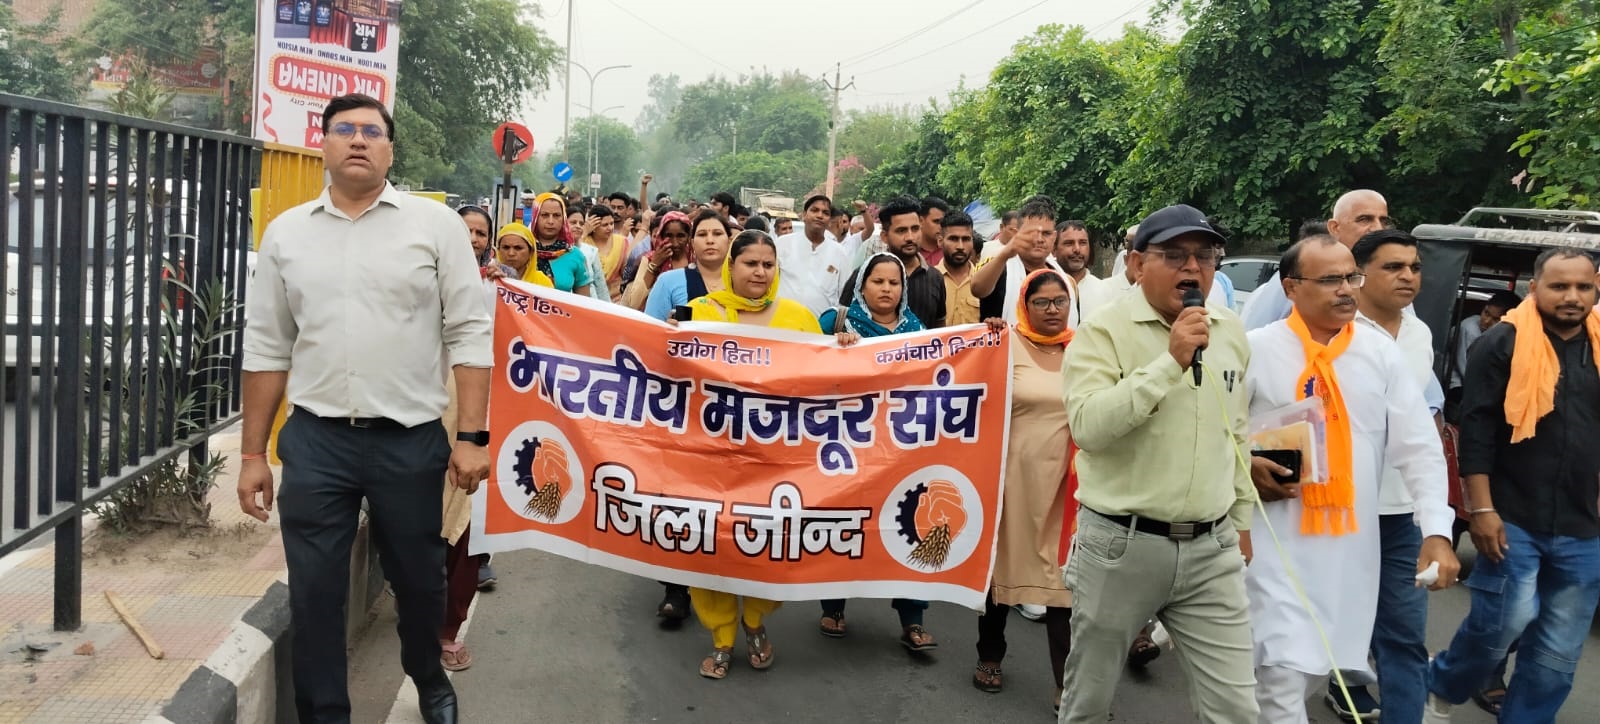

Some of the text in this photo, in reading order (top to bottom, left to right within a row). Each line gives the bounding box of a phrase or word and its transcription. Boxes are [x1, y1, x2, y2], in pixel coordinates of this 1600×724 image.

[355, 22, 376, 38] MR
[300, 46, 313, 55] NEW
[340, 54, 353, 63] NEW
[277, 61, 348, 97] CINEMA
[667, 337, 718, 360] उद्योग
[876, 338, 943, 363] कर्मचारी
[509, 337, 987, 474] भारतीय मजदूर संघ
[592, 462, 873, 561] जिला जीन्द
